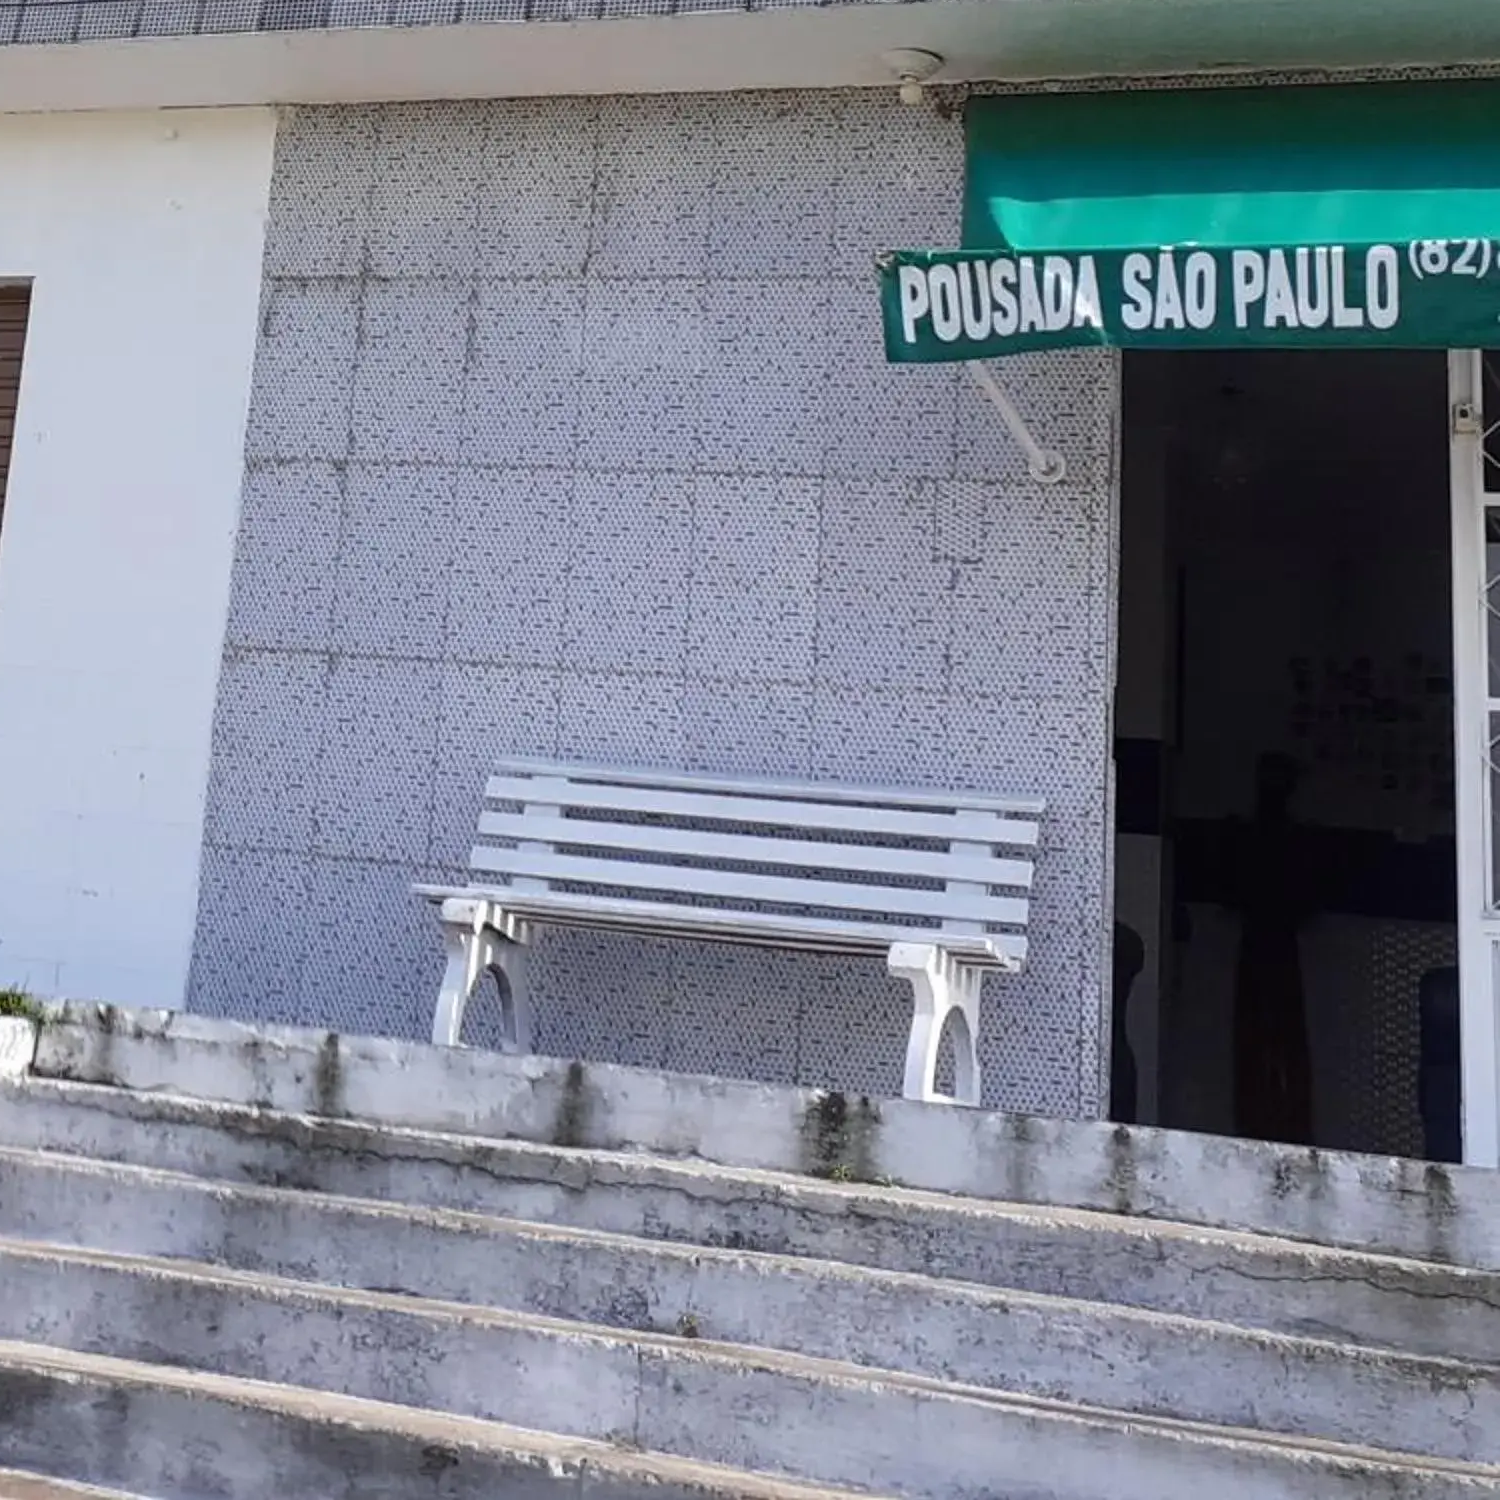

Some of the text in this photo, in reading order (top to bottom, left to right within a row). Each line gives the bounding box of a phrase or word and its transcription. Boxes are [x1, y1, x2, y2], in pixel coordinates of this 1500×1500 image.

[899, 255, 1104, 343] POUSADA
[1232, 244, 1399, 329] PAULO
[1408, 238, 1491, 280] (82)
